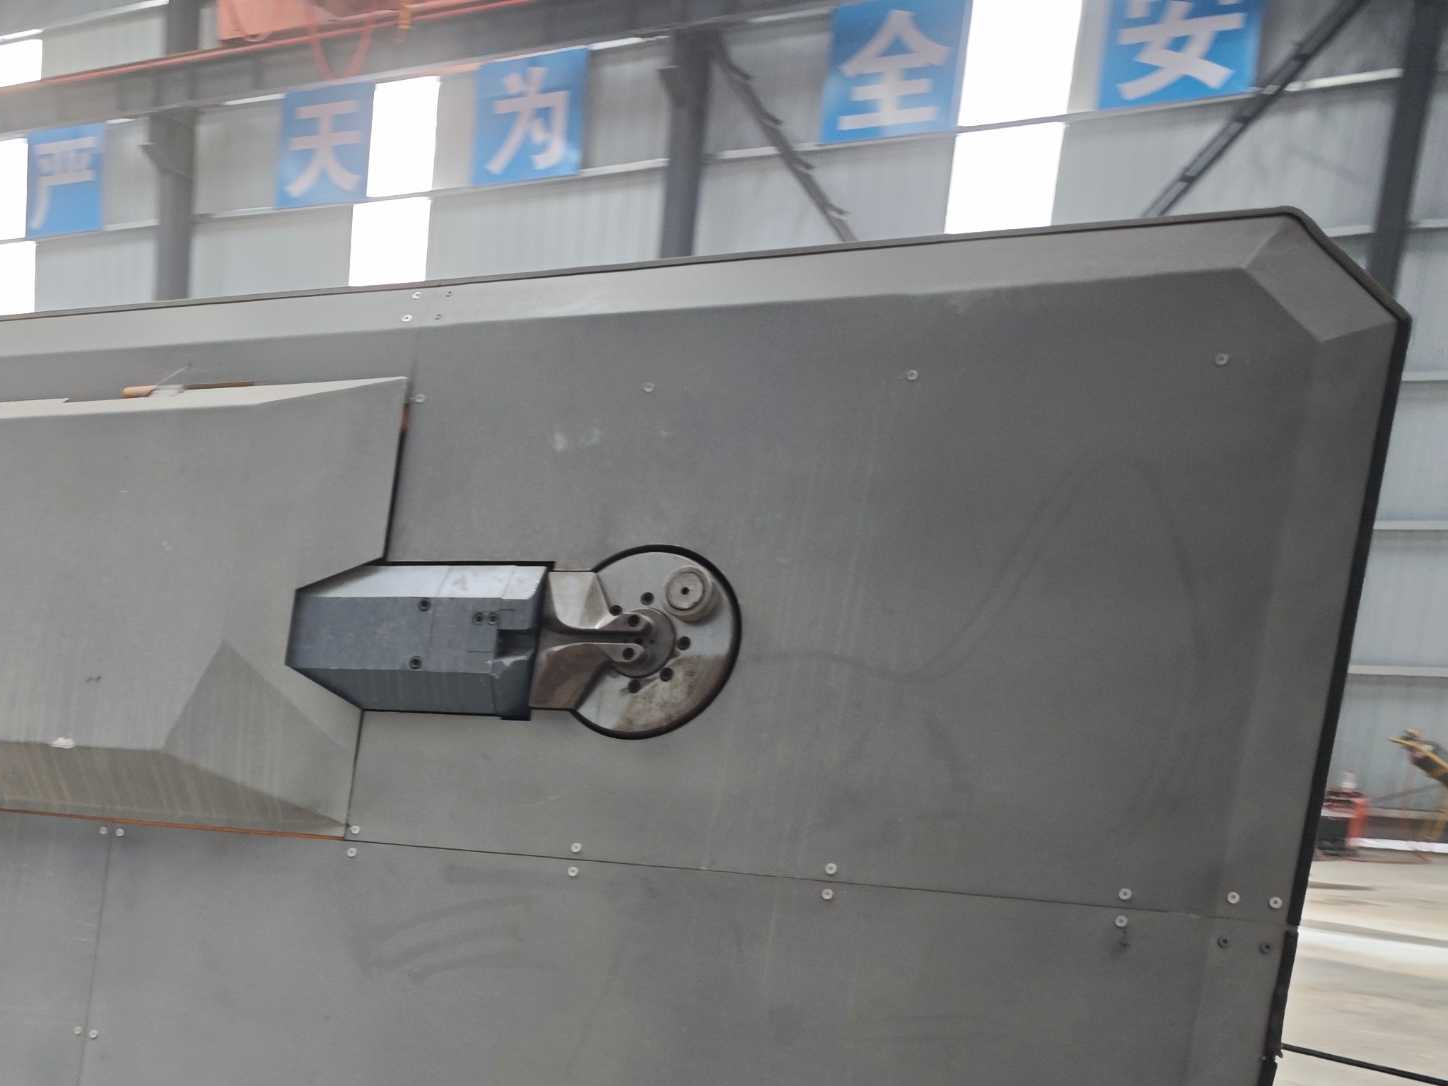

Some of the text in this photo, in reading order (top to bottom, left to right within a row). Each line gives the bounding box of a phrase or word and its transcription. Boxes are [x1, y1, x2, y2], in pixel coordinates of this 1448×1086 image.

[485, 66, 570, 174] 为
[837, 9, 952, 131] 全
[30, 136, 97, 230] 严
[284, 100, 362, 198] 天
